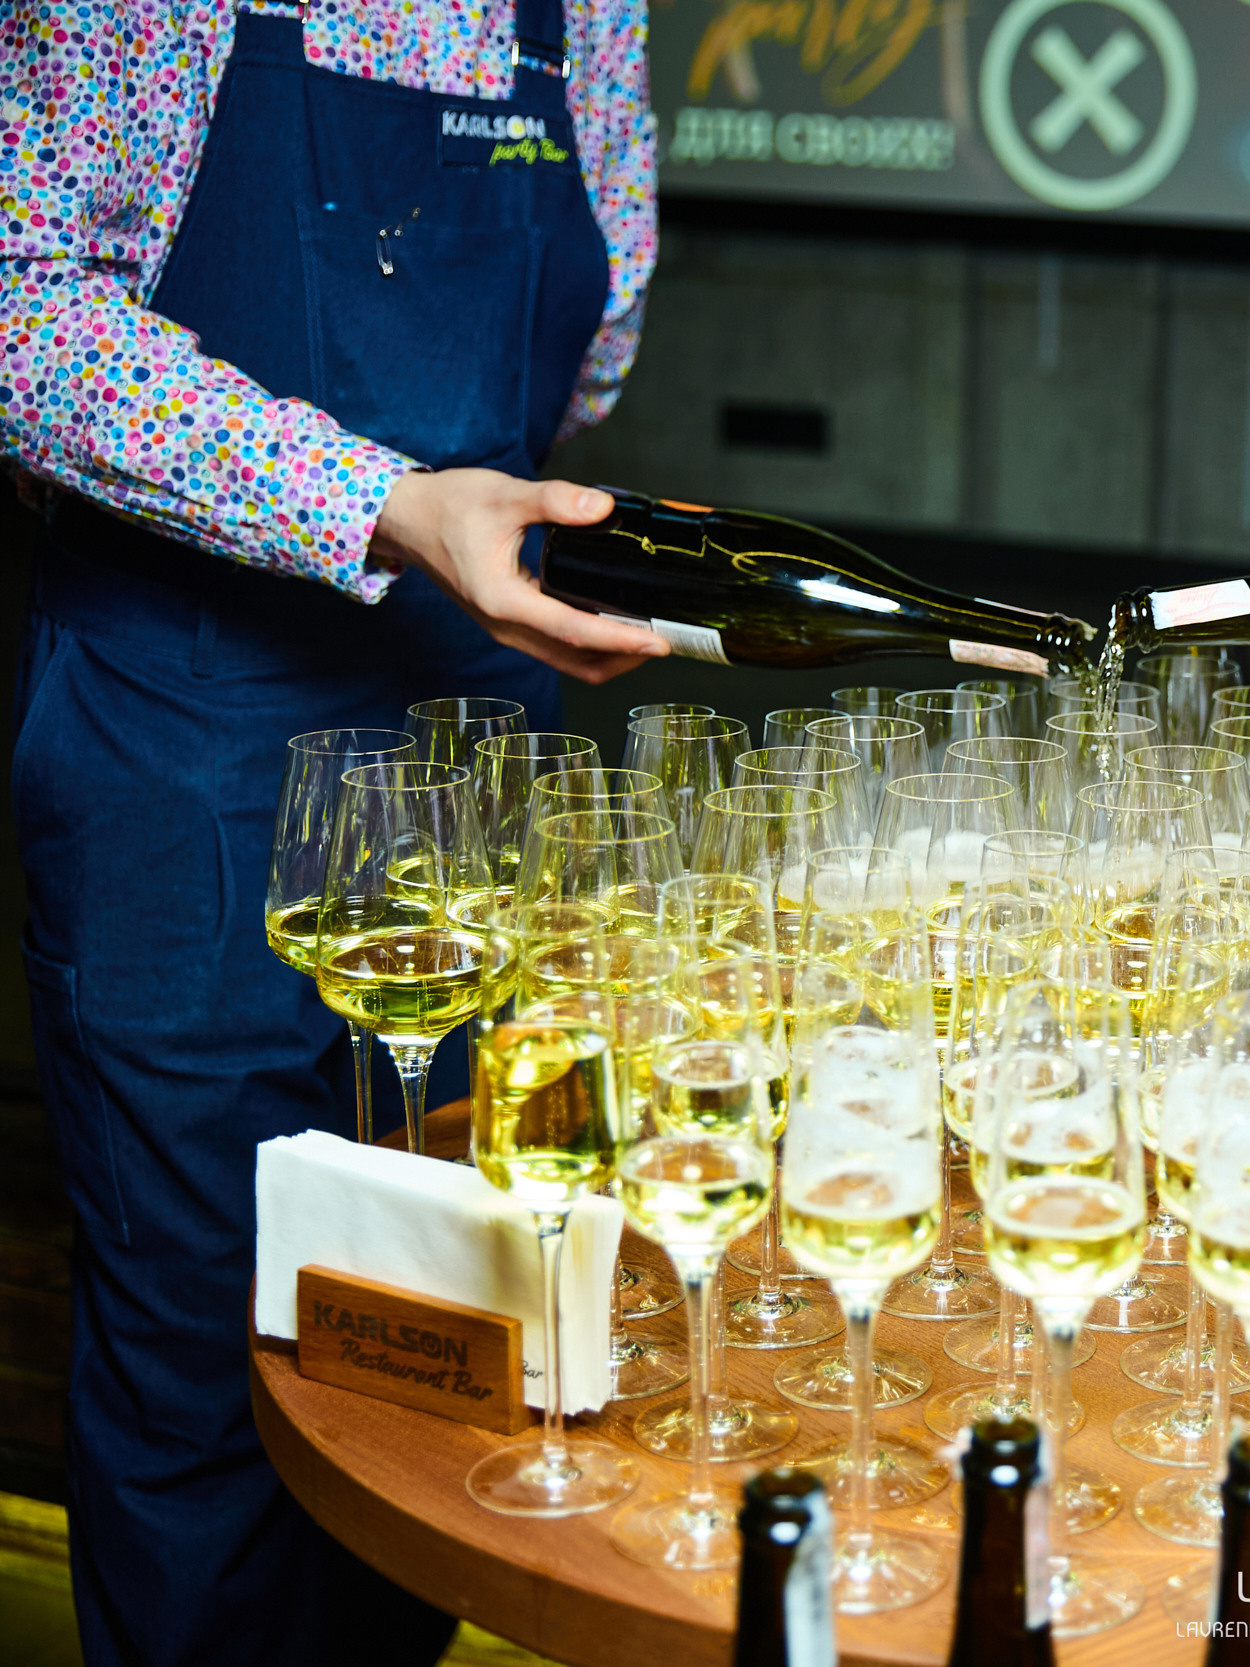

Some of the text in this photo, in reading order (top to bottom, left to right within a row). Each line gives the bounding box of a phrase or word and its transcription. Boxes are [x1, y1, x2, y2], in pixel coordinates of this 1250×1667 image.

[442, 110, 546, 140] KARLSON
[313, 1299, 469, 1368] KARLSON
[340, 1337, 494, 1401] Restaurant Bar
